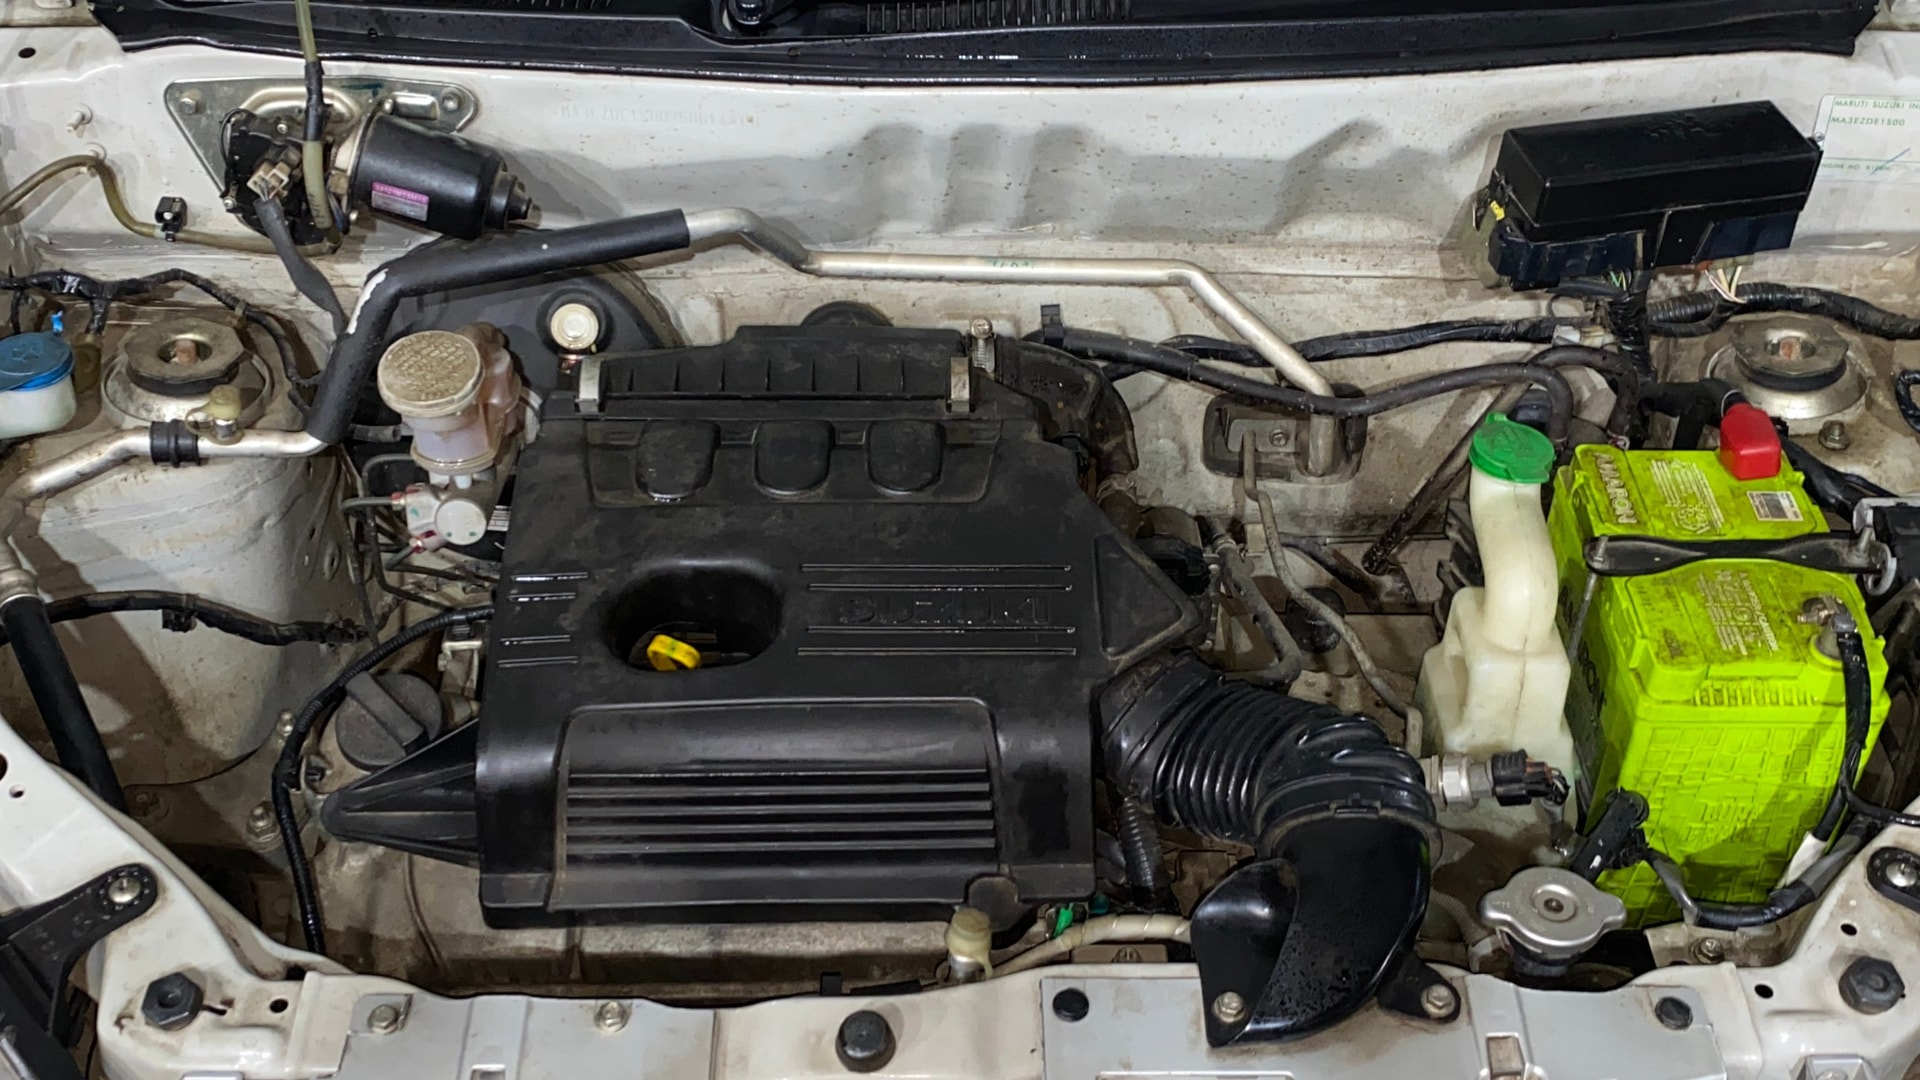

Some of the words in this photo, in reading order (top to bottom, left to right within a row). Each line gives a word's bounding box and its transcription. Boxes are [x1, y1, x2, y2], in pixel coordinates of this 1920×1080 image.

[1834, 99, 1868, 108] MARUTI
[1872, 101, 1905, 109] SUZUKI
[1592, 451, 1638, 524] AMARON
